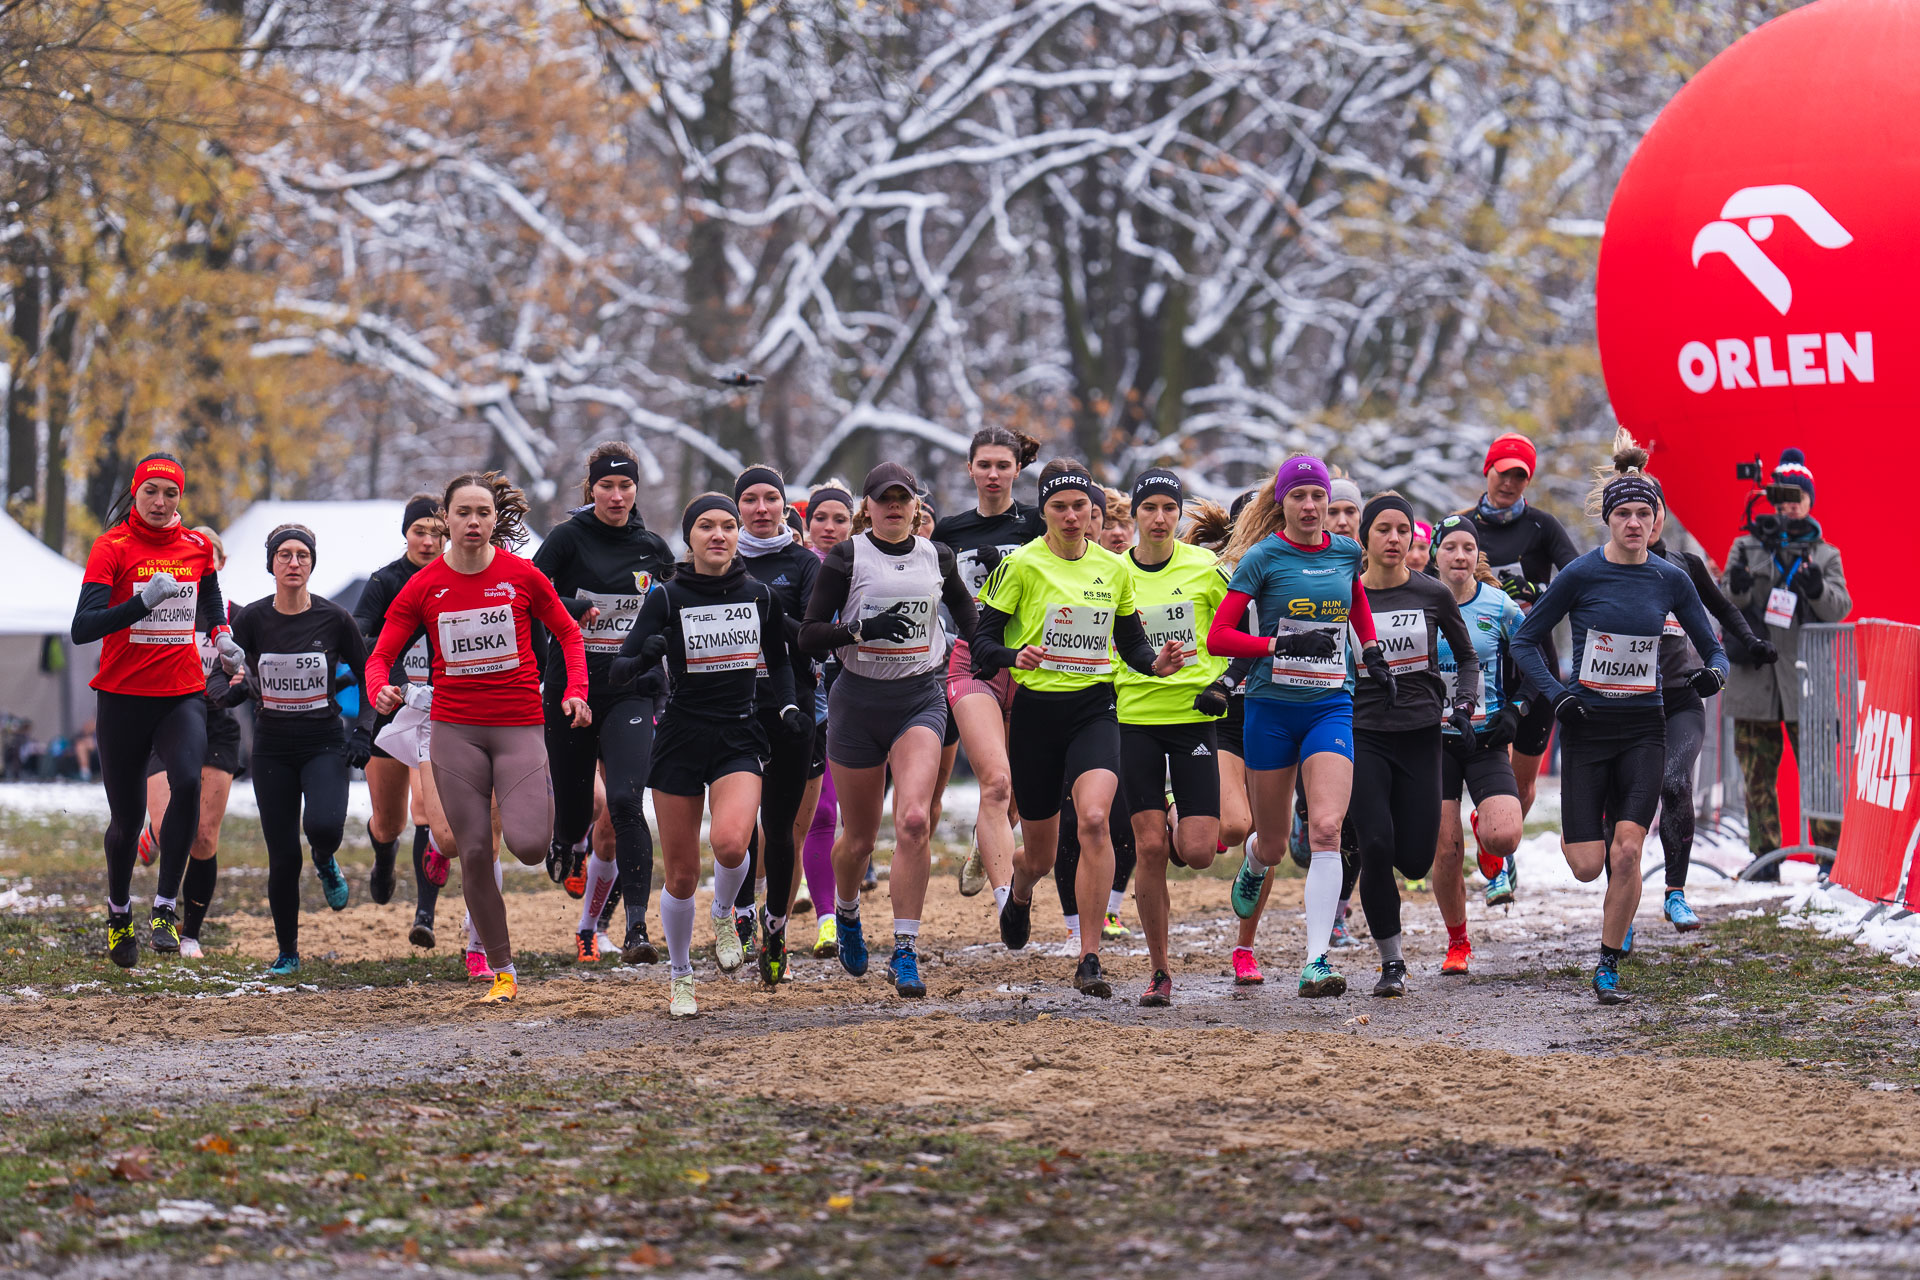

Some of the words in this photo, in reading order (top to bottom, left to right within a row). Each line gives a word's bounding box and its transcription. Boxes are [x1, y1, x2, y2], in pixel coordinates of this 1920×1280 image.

[1677, 331, 1875, 394] ORLEN
[1049, 476, 1088, 488] TERREX
[1144, 476, 1179, 490] TERREX
[615, 599, 638, 610] 148
[901, 601, 928, 614] 570
[480, 610, 507, 625] 366
[692, 614, 717, 622] FUEL
[725, 607, 752, 621] 240
[1093, 612, 1109, 625] 17
[1166, 607, 1184, 620] 18
[1391, 613, 1418, 627] 277
[451, 634, 507, 654] JELSKA
[688, 628, 759, 650] SZYMAŃSKA
[1045, 629, 1107, 650] ŚCISŁOWSKA
[1594, 645, 1614, 653] ORLEN
[1629, 640, 1653, 653] 134
[296, 657, 321, 669] 595
[706, 663, 731, 671] BYTOM
[1590, 659, 1649, 677] MISJAN
[461, 666, 486, 674] BYTOM
[262, 676, 325, 691] MUSIELAK
[1289, 678, 1315, 686] BYTOM
